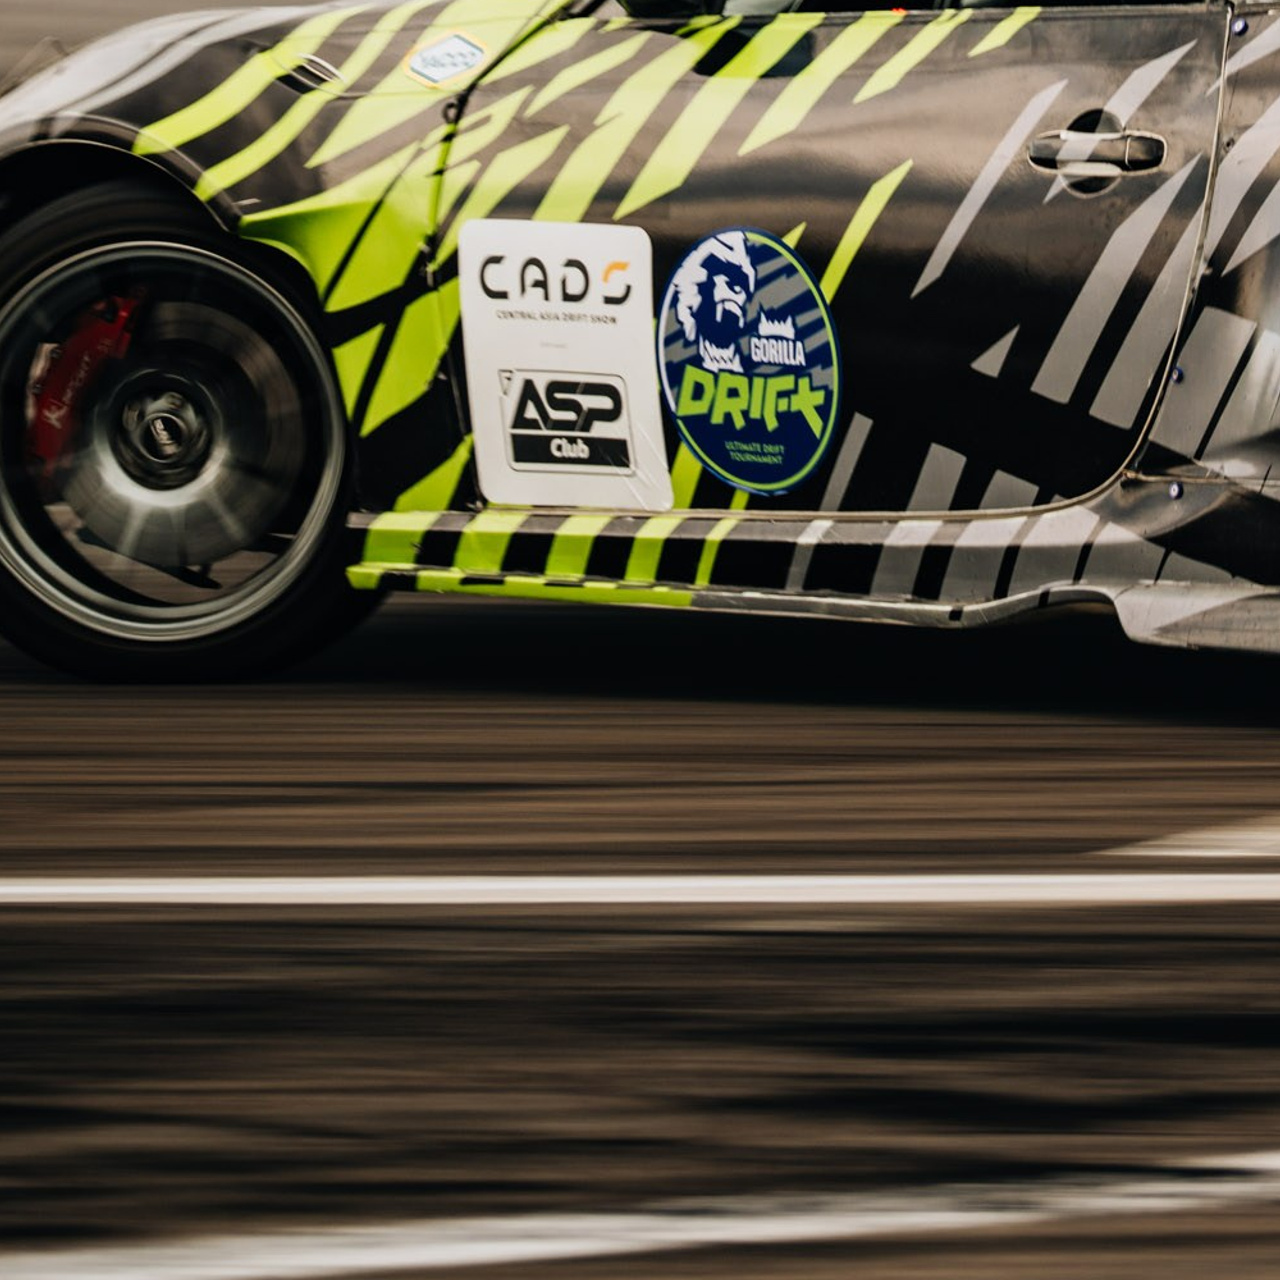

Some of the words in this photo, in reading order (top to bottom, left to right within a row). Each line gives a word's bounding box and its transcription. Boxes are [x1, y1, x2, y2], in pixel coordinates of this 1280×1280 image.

[479, 255, 632, 305] CADS
[496, 310, 538, 320] CENTRAL
[540, 311, 560, 320] ASIA
[562, 313, 588, 322] DRIFT
[590, 315, 617, 324] SHOW
[751, 337, 806, 366] GORILLA
[512, 379, 622, 432] ASP
[550, 438, 590, 459] Club
[725, 441, 761, 452] ULTIMATE
[763, 444, 784, 454] DRIFT
[730, 451, 783, 464] TOURNAMENT
